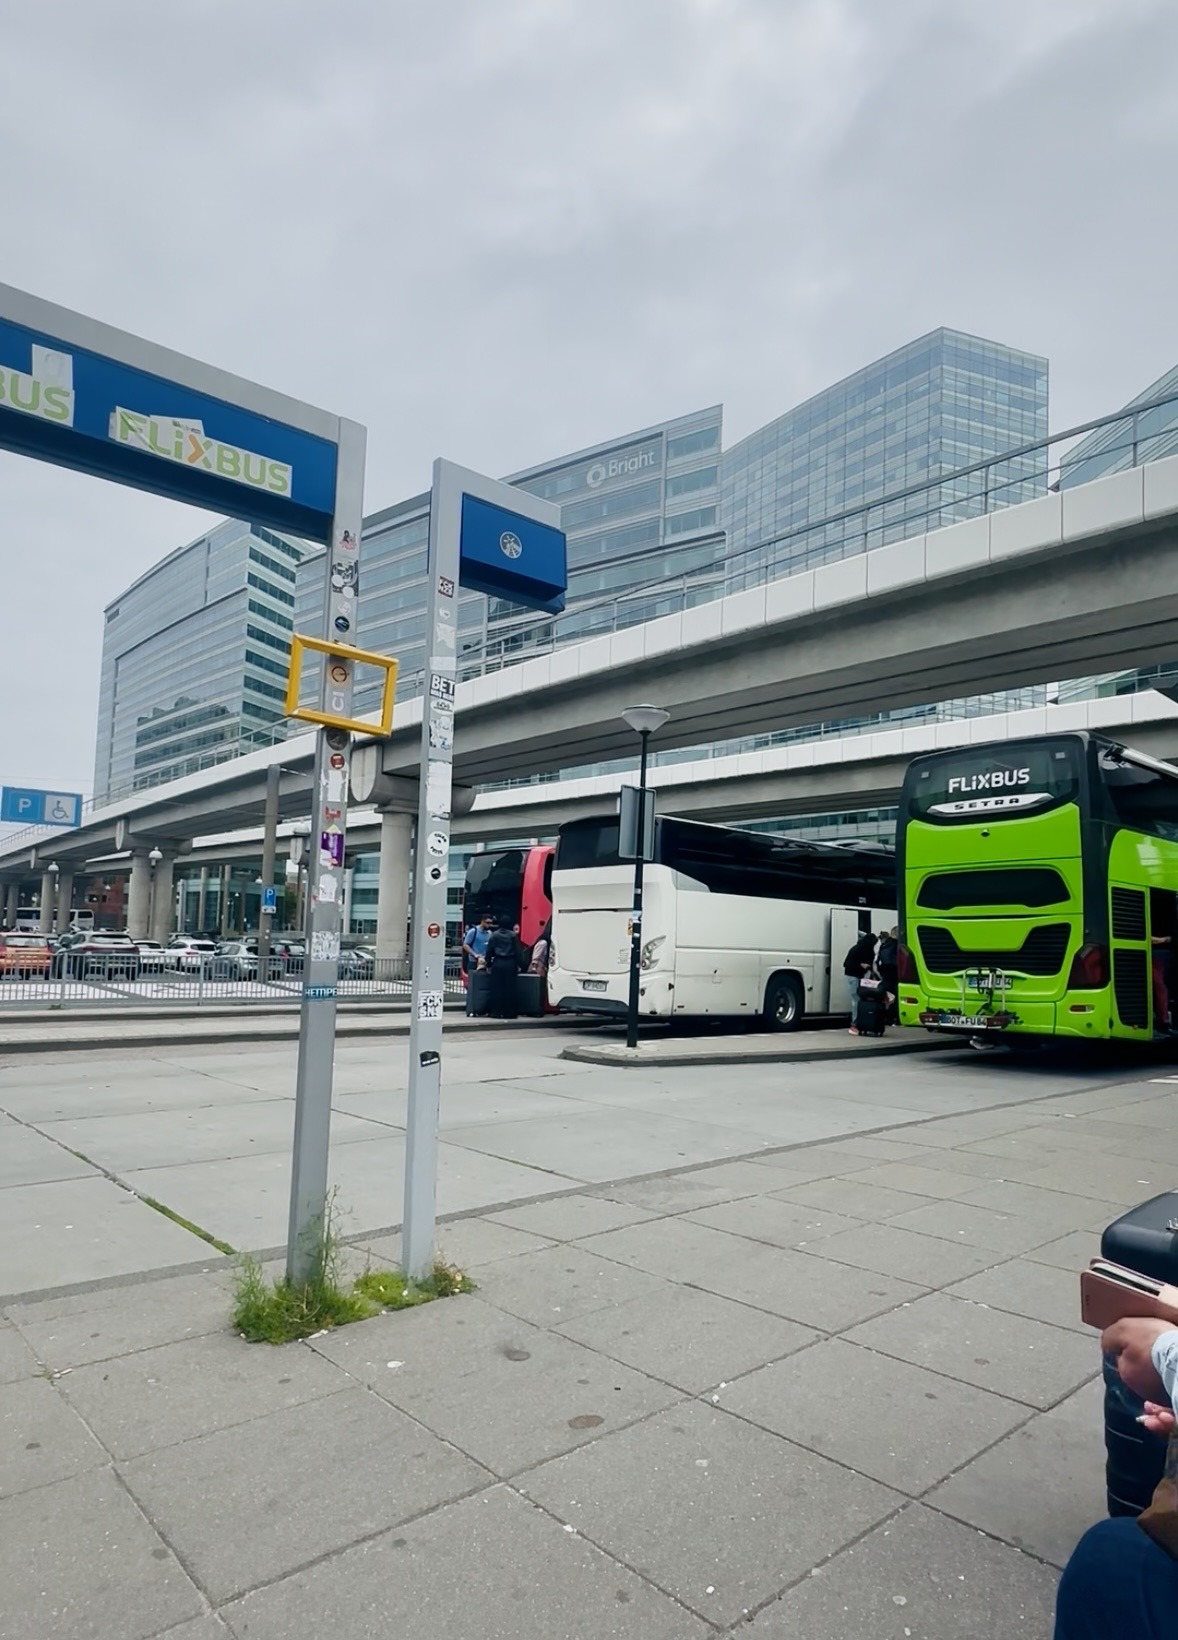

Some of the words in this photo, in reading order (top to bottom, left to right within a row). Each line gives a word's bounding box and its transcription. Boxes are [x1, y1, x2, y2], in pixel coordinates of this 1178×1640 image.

[0, 369, 70, 420] US
[608, 450, 655, 477] Bright
[18, 797, 32, 813] P
[954, 797, 1020, 811] SETRA
